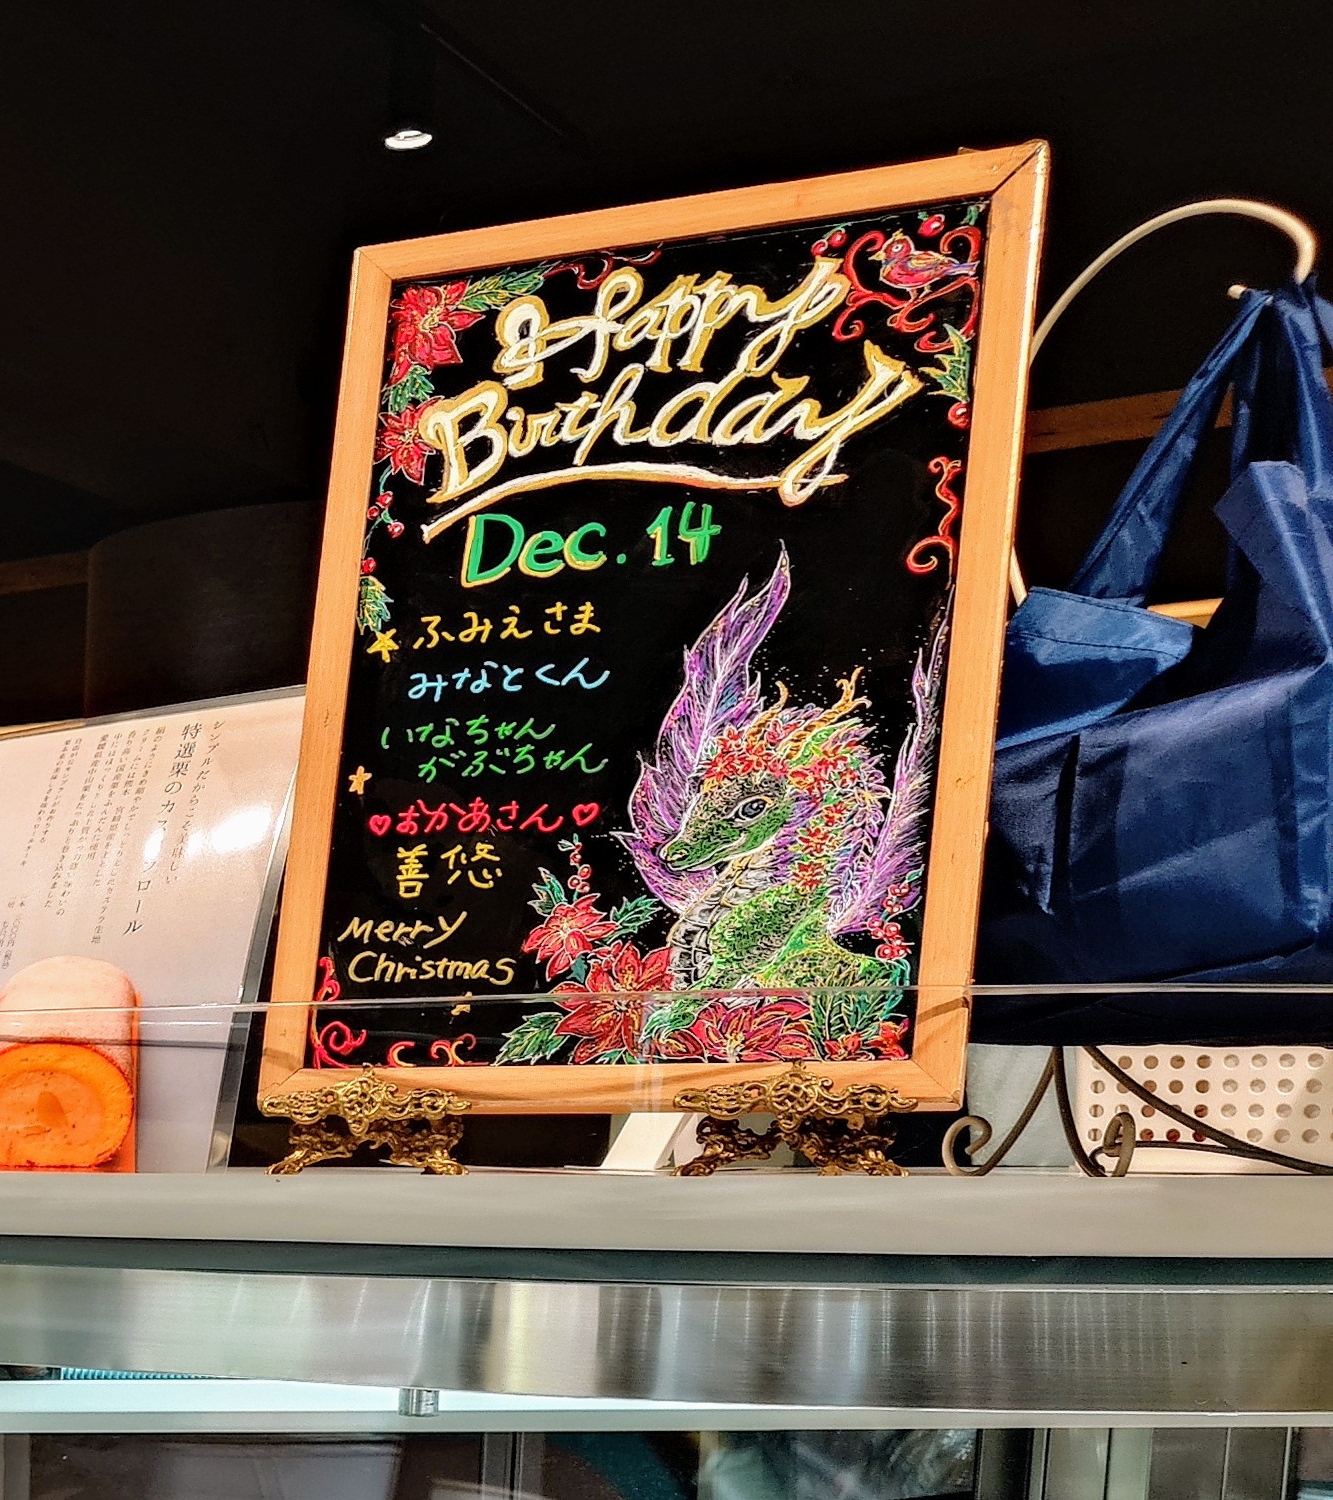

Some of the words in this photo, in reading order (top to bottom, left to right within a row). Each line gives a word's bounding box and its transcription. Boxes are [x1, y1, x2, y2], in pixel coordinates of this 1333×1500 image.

[495, 259, 854, 388] Happy
[420, 341, 924, 505] Birthday
[460, 513, 628, 588] Dec.
[647, 503, 723, 568] 14
[413, 601, 601, 650] ふみえさま
[408, 657, 610, 702] みなとくん
[395, 796, 563, 836] おかあさん
[337, 911, 468, 949] Merry
[348, 951, 516, 985] Christmas
